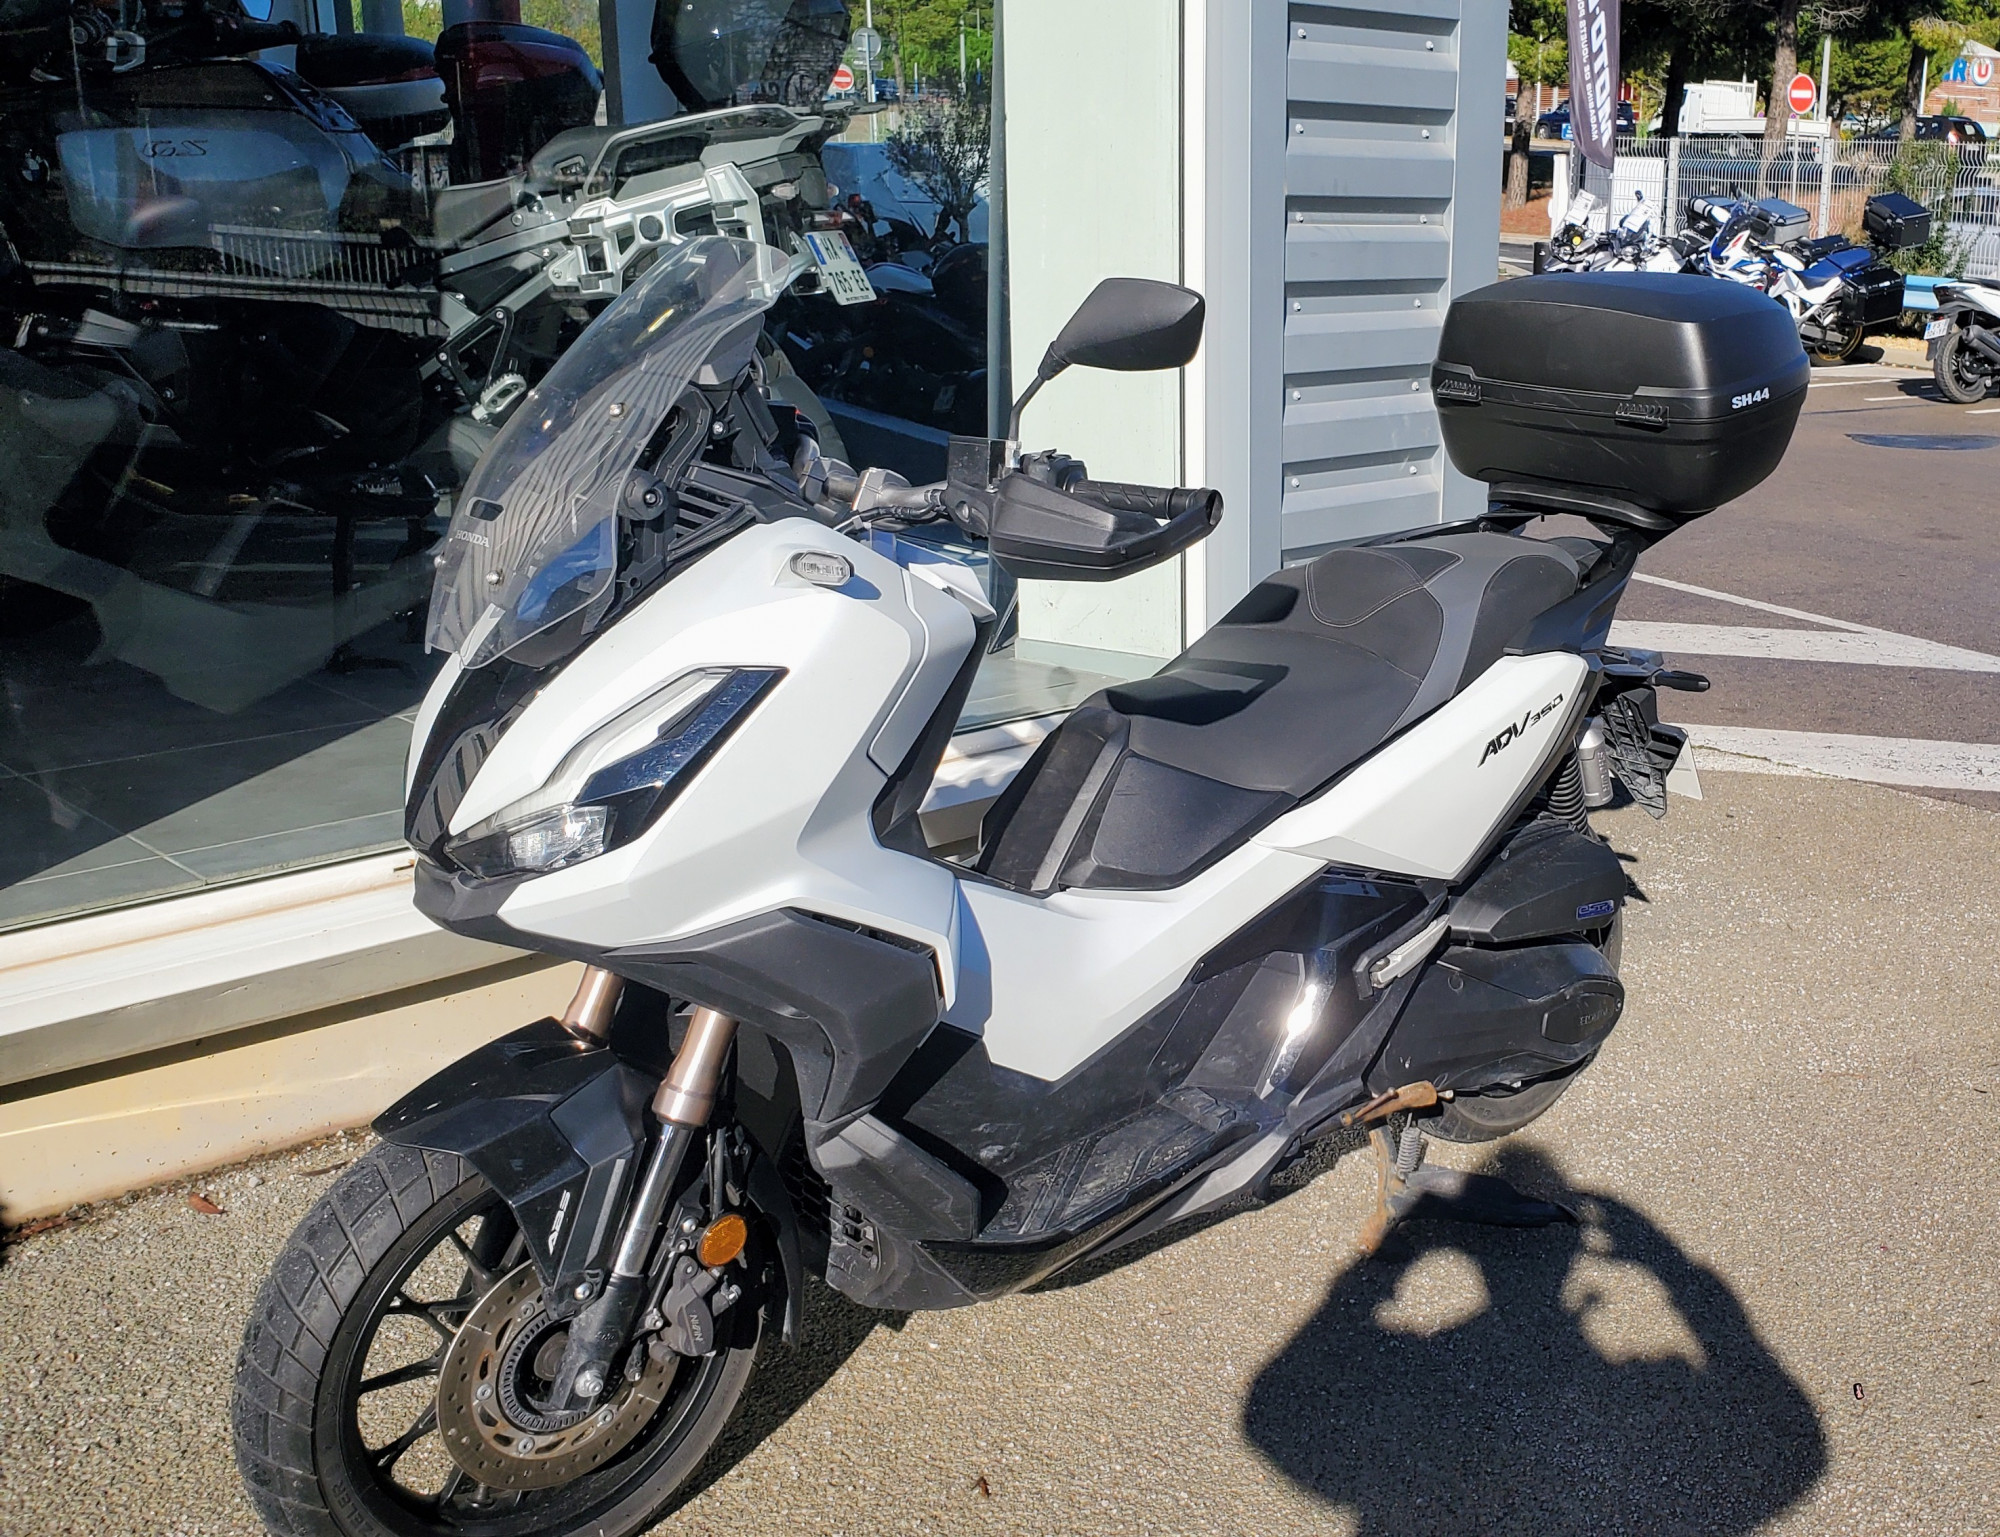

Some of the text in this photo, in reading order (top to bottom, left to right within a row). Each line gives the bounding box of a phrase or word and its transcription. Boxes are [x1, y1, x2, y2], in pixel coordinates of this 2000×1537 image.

[1731, 387, 1770, 410] SH44
[455, 529, 490, 548] HONDA
[548, 1190, 571, 1256] ABS
